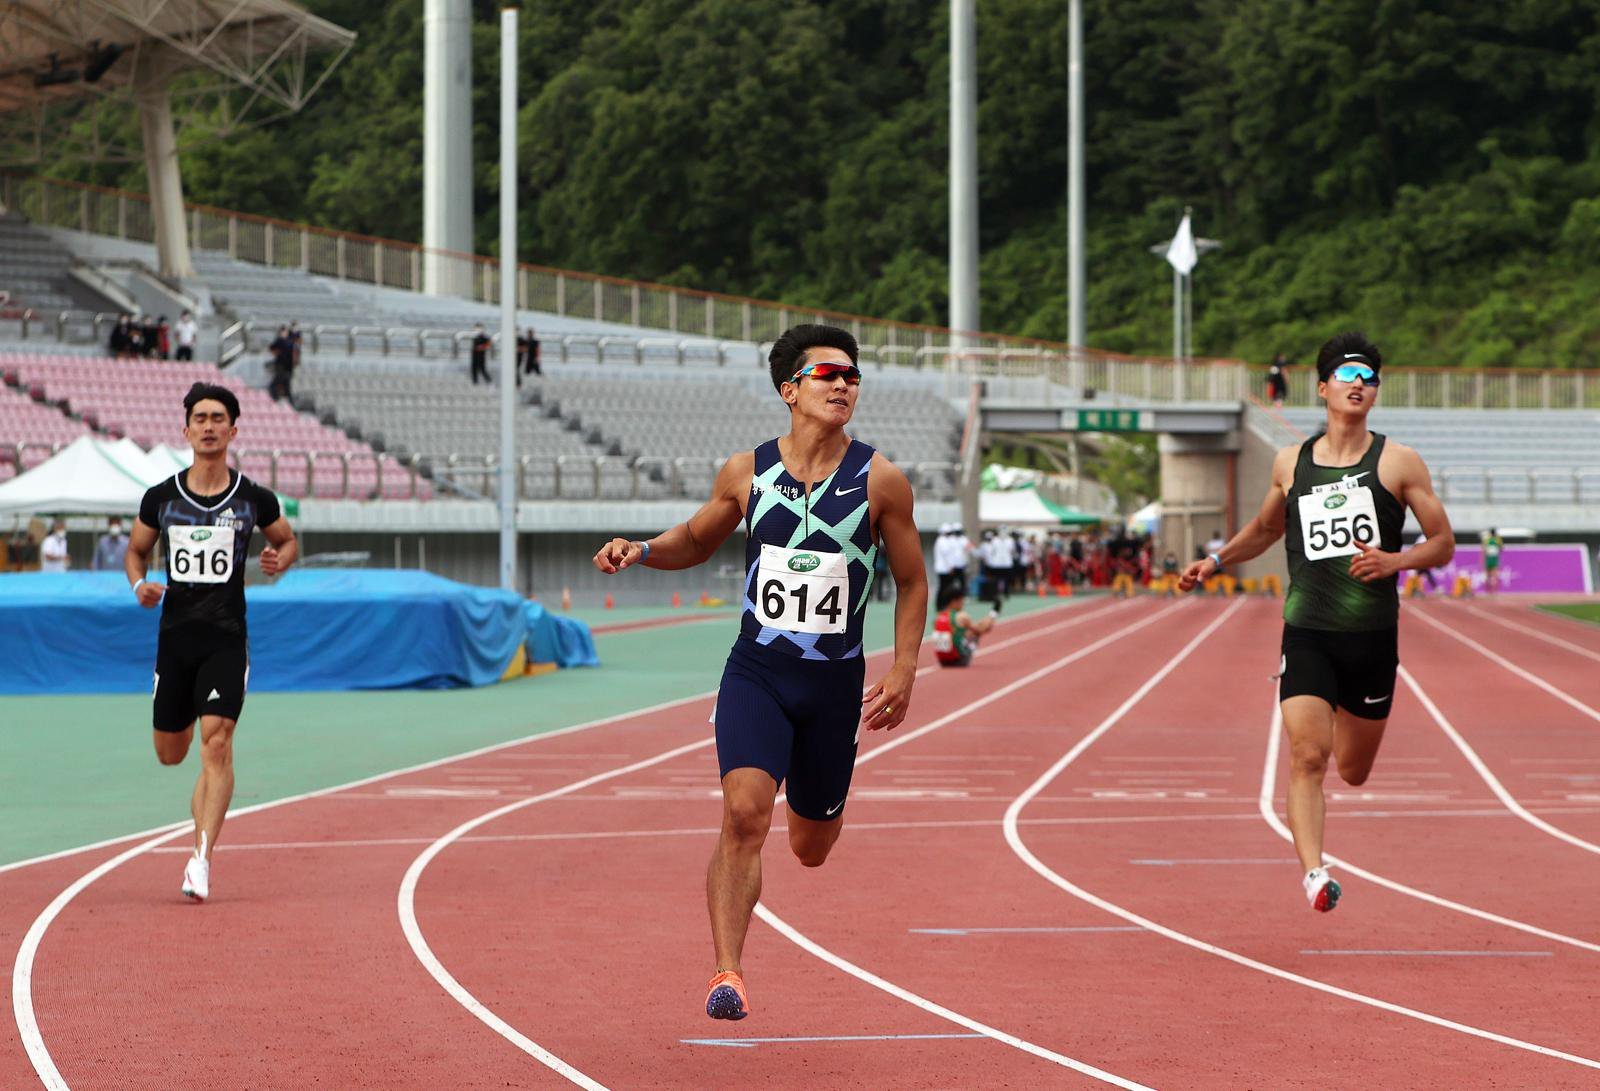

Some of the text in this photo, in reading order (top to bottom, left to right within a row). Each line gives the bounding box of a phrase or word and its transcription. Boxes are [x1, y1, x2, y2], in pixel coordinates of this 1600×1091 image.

[1309, 513, 1374, 551] 556
[174, 548, 229, 576] 616
[762, 579, 842, 624] 614
